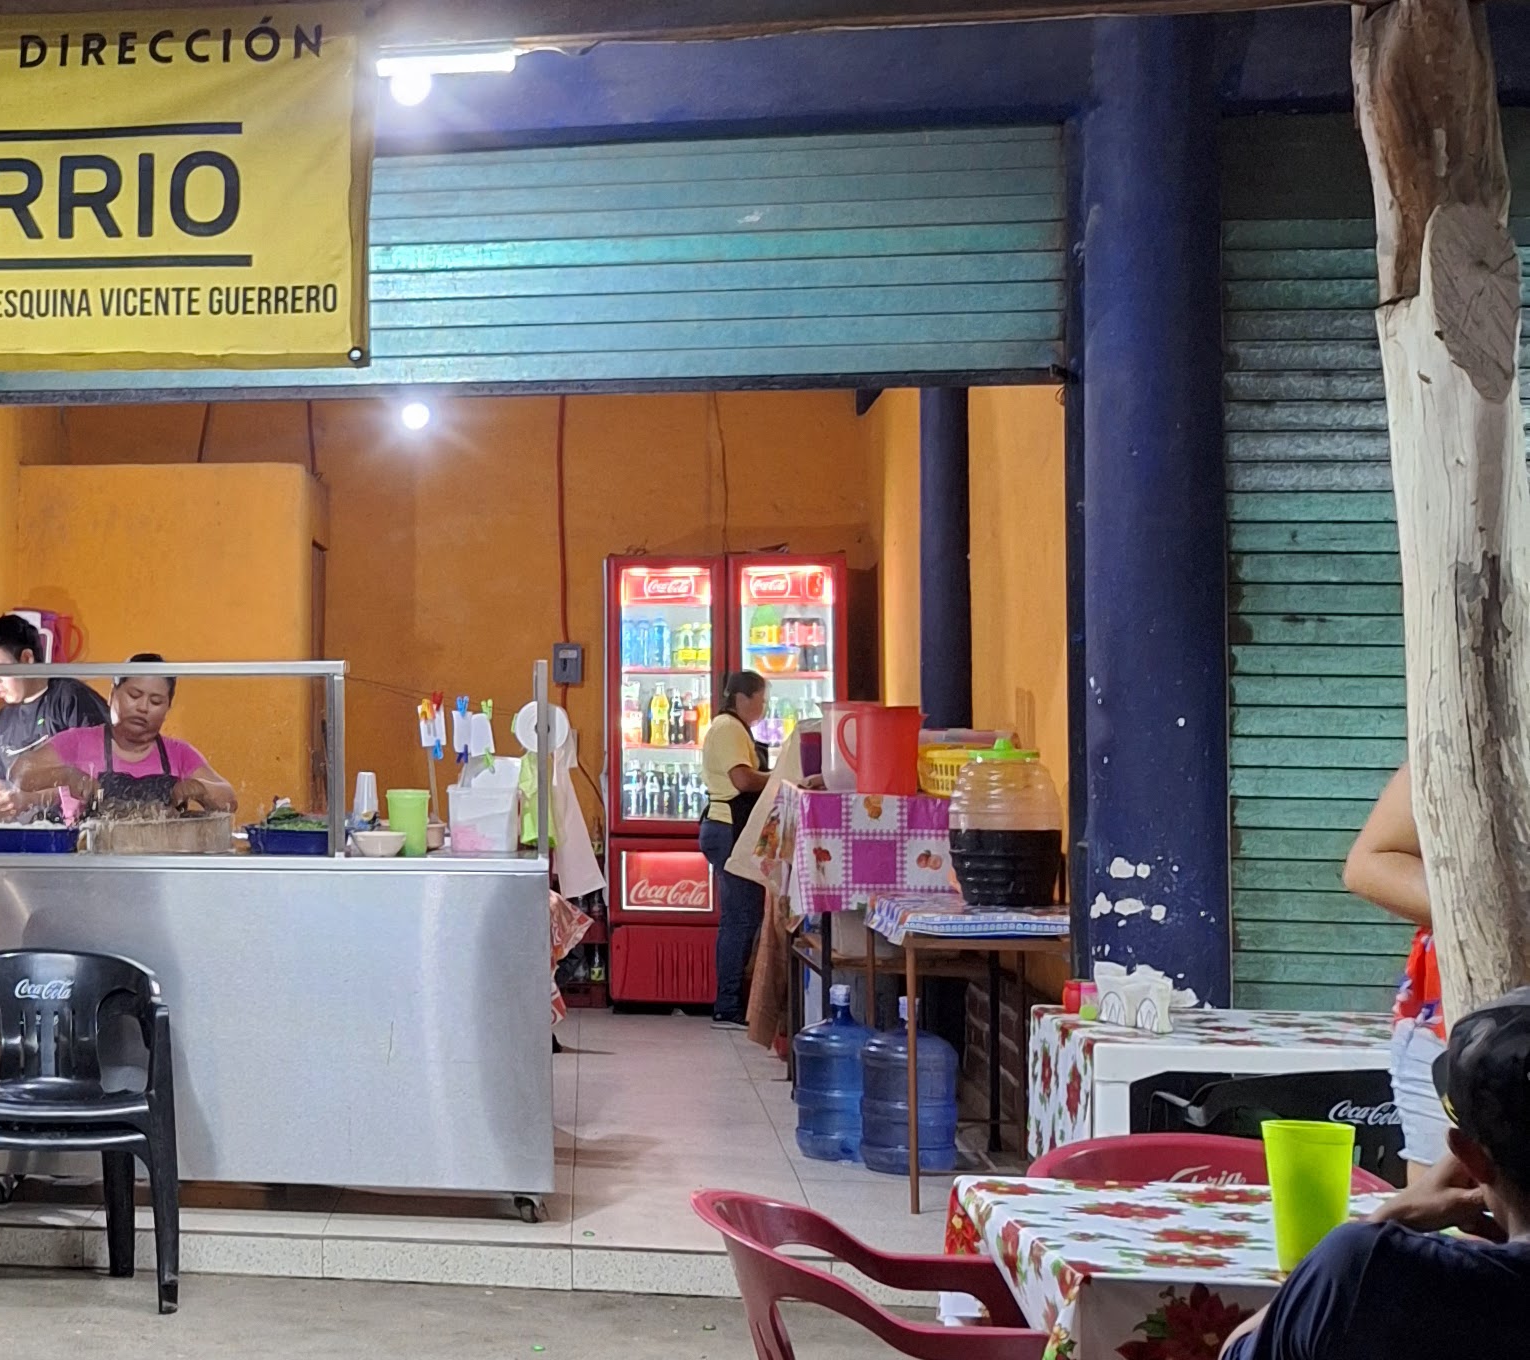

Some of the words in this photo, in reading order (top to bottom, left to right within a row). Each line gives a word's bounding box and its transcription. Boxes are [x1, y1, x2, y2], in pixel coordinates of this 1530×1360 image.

[19, 17, 323, 69] DIRECCIÓN
[100, 287, 200, 316] VICENTE
[209, 284, 336, 315] GUERRERO
[629, 878, 707, 906] Coca-Cola
[14, 979, 75, 999] Coca-Cola
